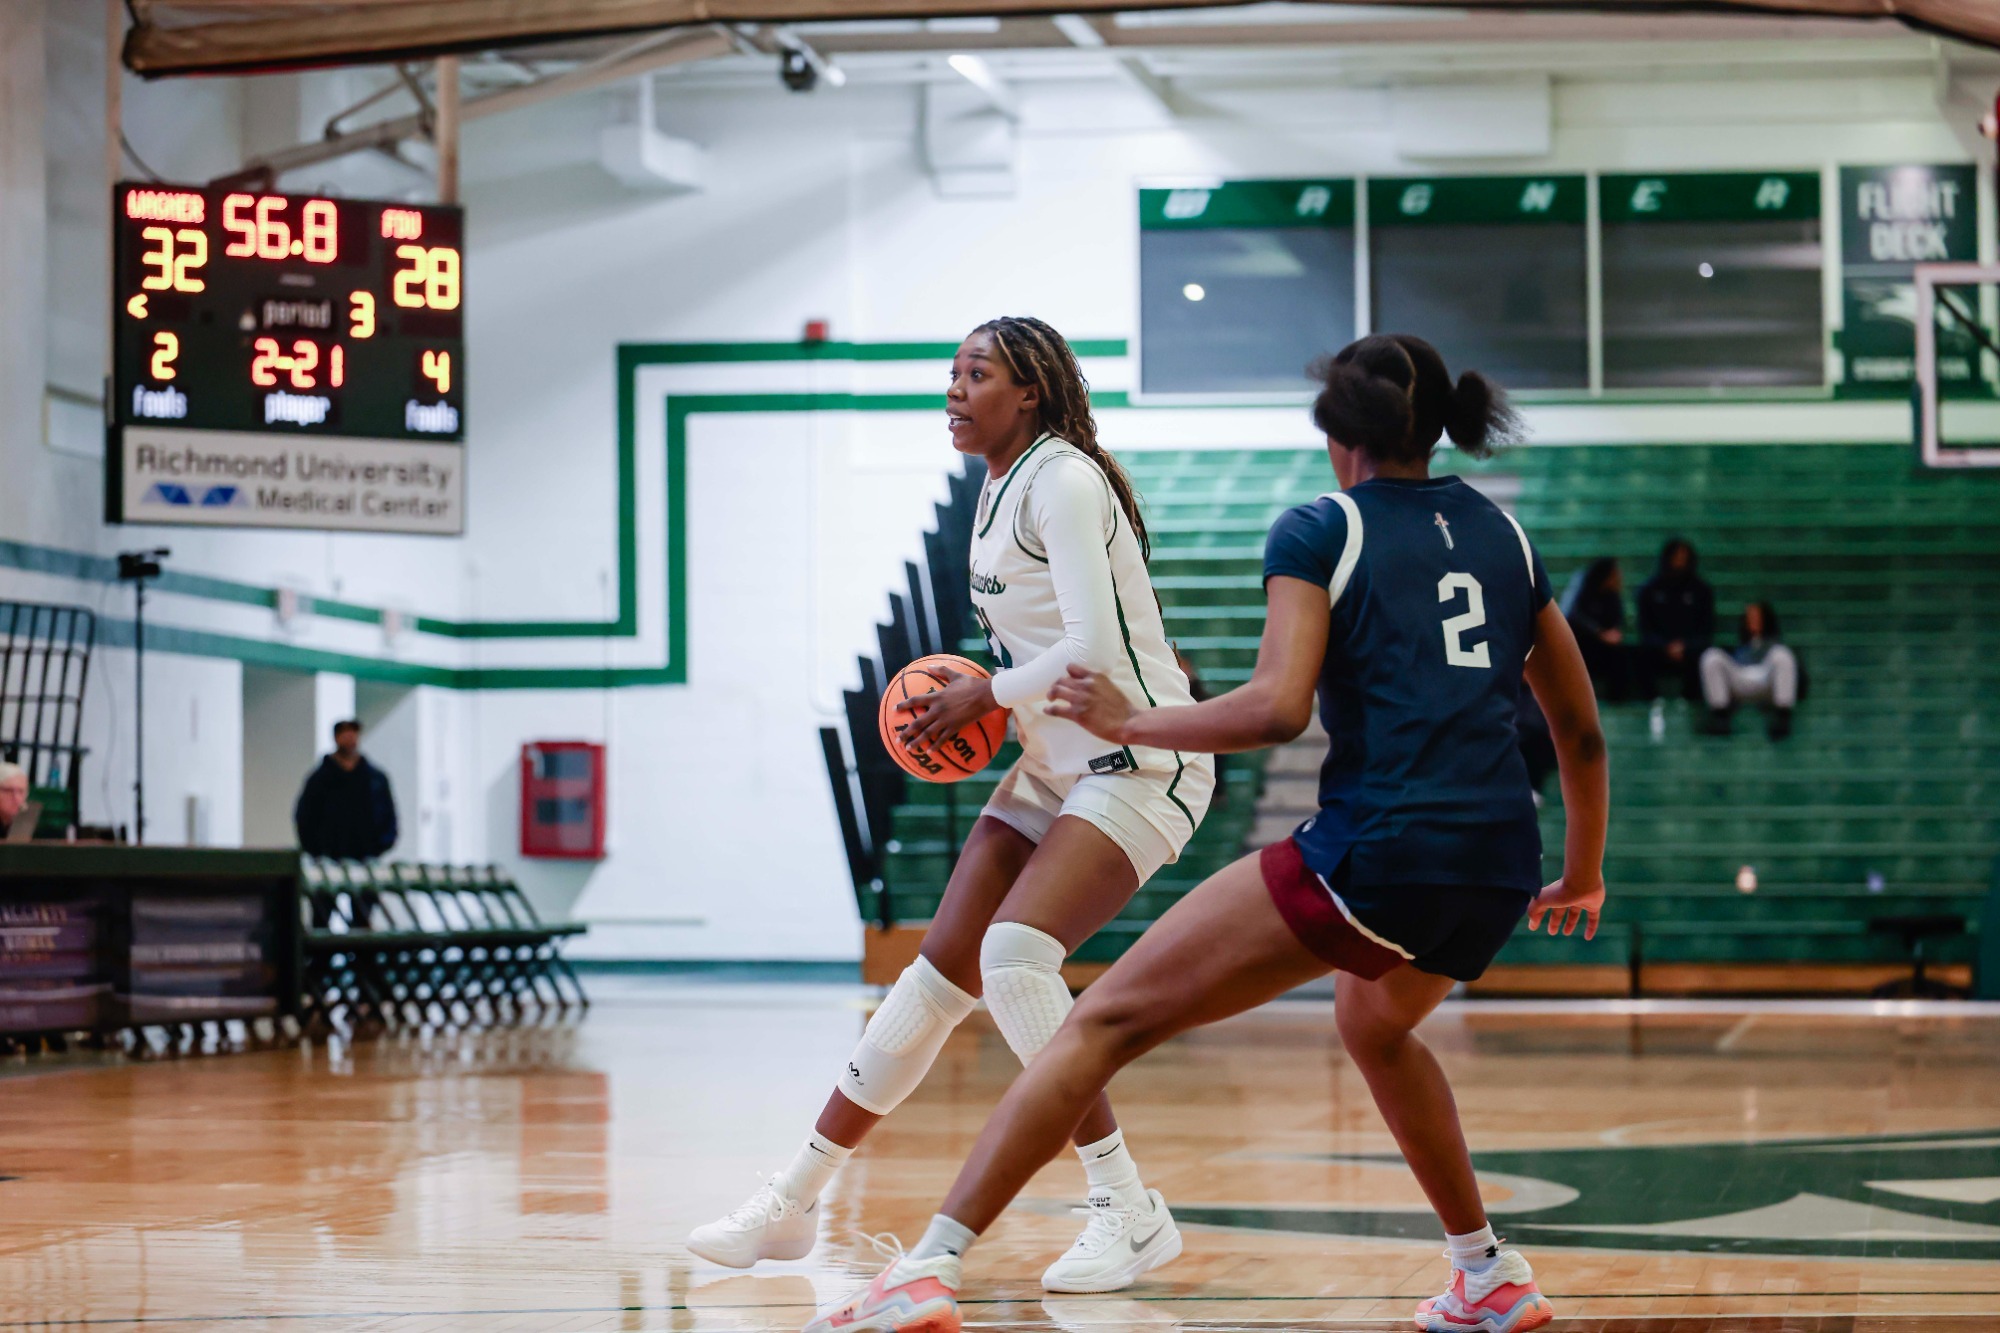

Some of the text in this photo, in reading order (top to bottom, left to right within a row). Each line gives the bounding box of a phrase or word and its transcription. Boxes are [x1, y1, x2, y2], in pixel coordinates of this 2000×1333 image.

[222, 193, 338, 264] 56.8
[380, 208, 423, 240] FDU
[1870, 221, 1948, 261] DECK
[141, 226, 208, 293] 32
[393, 245, 460, 310] 28
[262, 300, 332, 334] period
[349, 291, 375, 339] 3
[151, 331, 179, 380] 2
[422, 350, 450, 394] 4
[136, 444, 452, 491] Richmond University
[256, 485, 449, 520] Medical Center
[1437, 571, 1492, 669] 2
